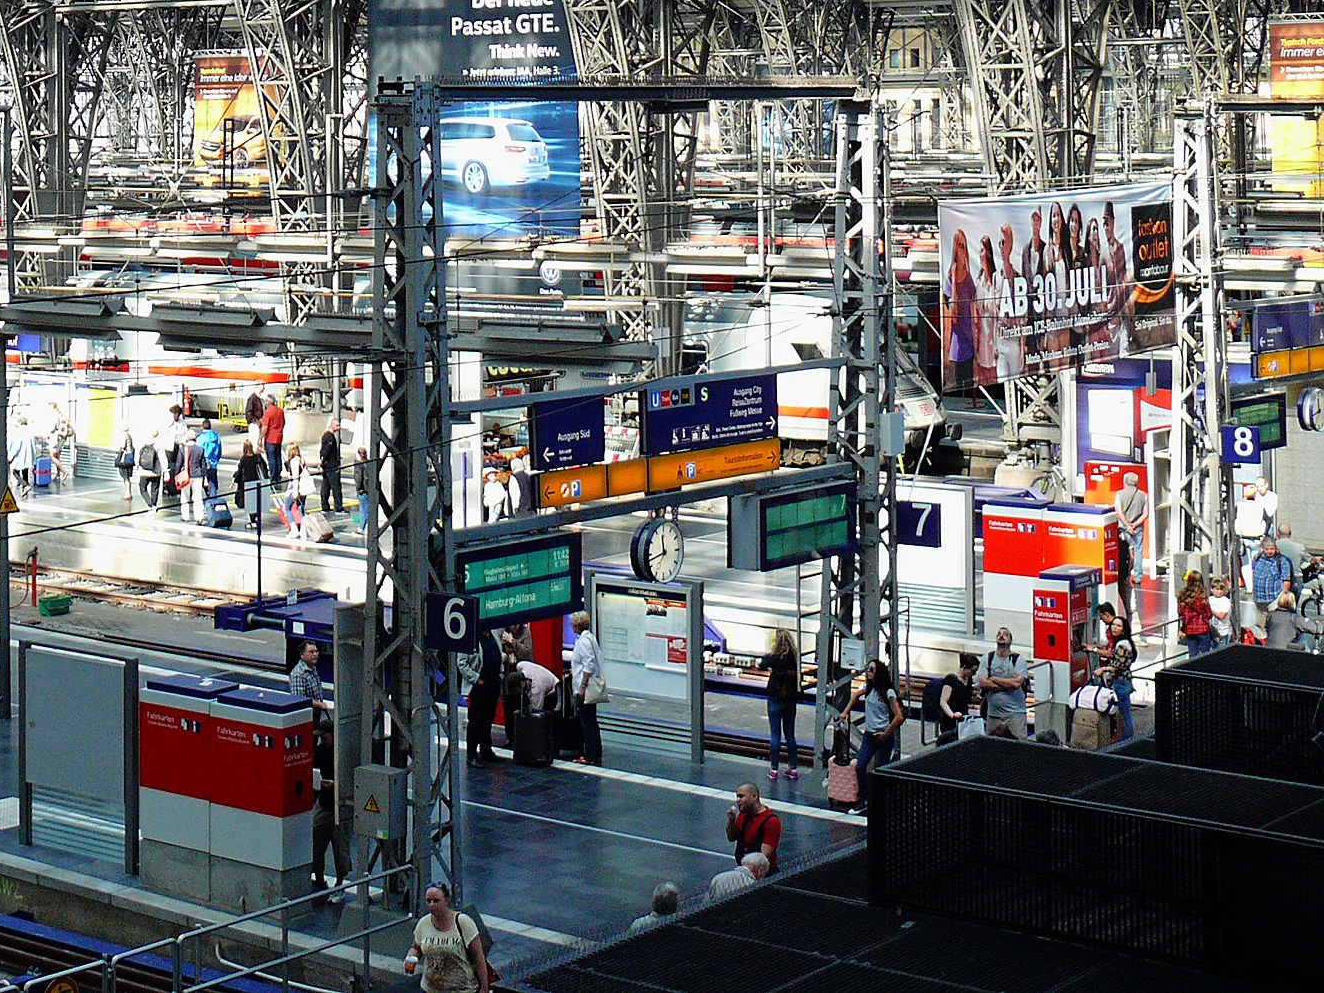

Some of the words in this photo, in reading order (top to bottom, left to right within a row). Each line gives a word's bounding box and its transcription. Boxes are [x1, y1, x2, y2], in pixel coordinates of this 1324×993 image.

[451, 16, 513, 36] Passat
[515, 13, 561, 34] GTE.
[1280, 38, 1307, 47] Typisch
[488, 43, 525, 59] Think
[526, 43, 561, 58] New.
[1280, 47, 1316, 58] Immer
[533, 66, 552, 75] Halle
[1138, 236, 1170, 261] outlet
[1000, 277, 1028, 318] AB
[1031, 271, 1062, 313] 30.
[999, 324, 1021, 338] Direkt
[1022, 325, 1033, 335] am
[700, 387, 708, 401] S
[733, 388, 752, 397] Ausgang
[753, 386, 762, 394] City
[557, 431, 579, 442] Ausgang
[580, 429, 591, 439] Süd
[1233, 426, 1254, 457] 8
[911, 502, 932, 537] 7
[485, 593, 536, 610] Hamburg-Altona
[443, 597, 467, 640] 6
[1034, 609, 1063, 619] Fahrkarten
[146, 711, 175, 724] Fahrkarten
[216, 725, 247, 738] Fahrkarten
[283, 750, 309, 763] Fahrkarten
